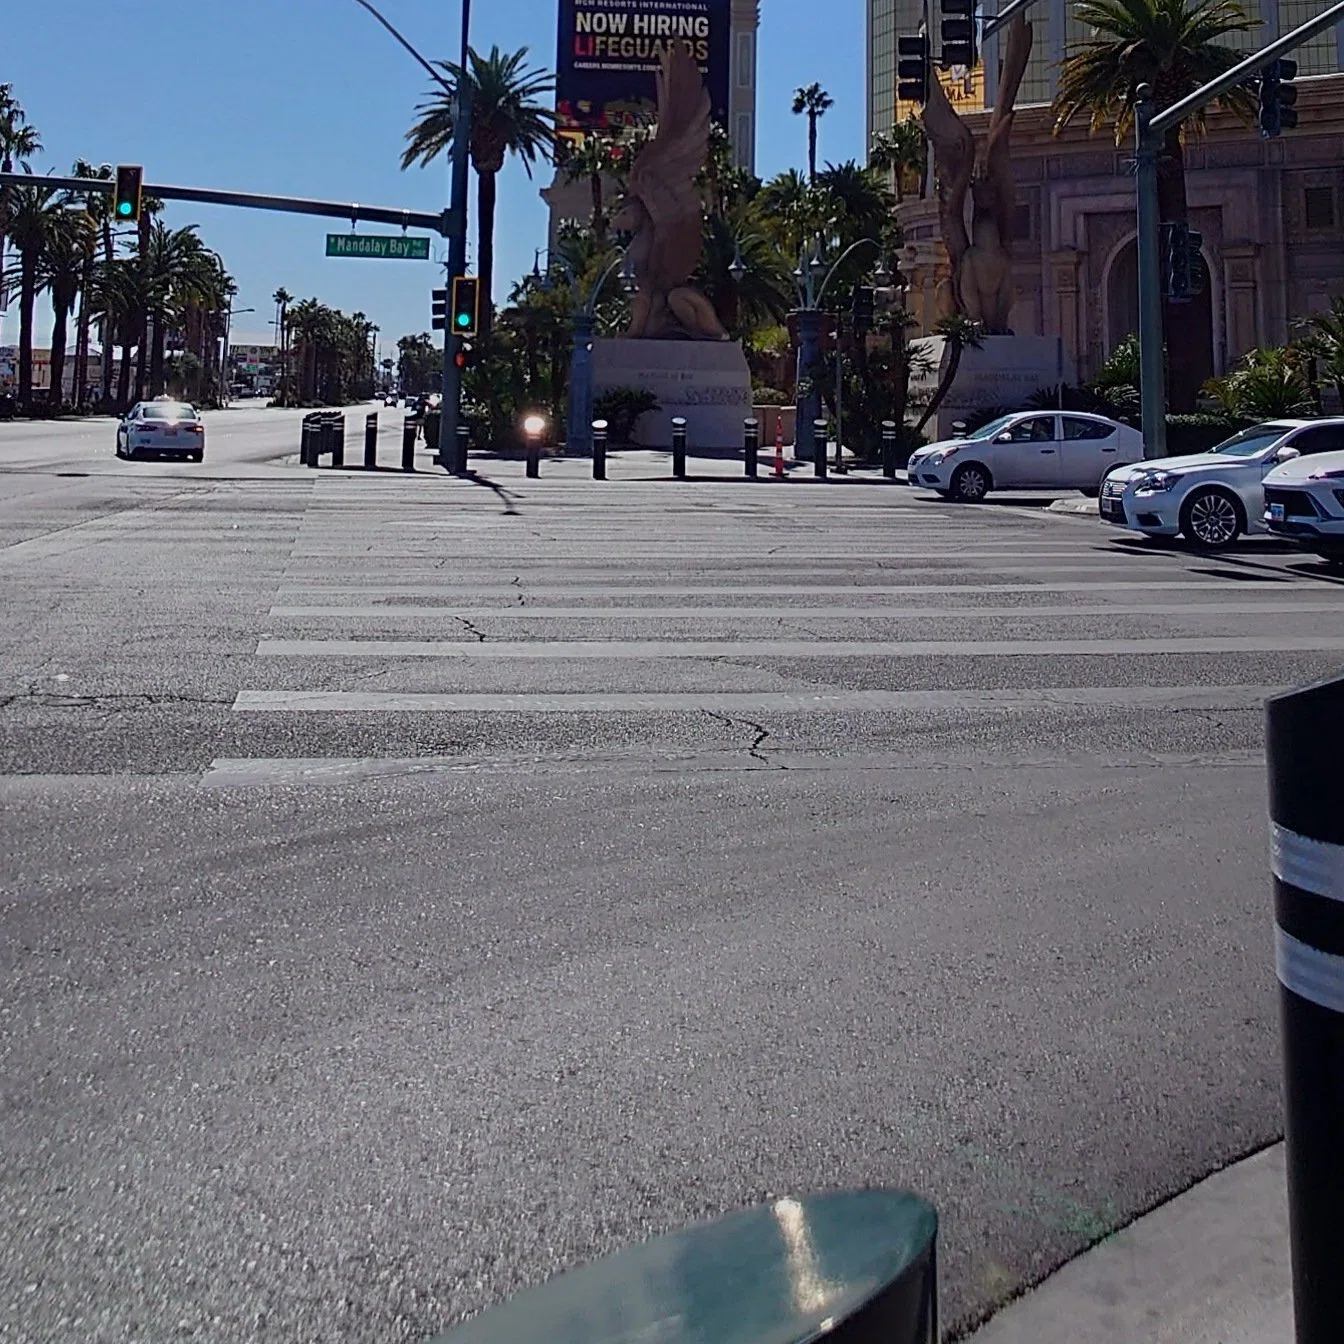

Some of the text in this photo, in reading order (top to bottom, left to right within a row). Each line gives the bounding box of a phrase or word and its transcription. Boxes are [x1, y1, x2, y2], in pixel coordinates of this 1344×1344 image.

[597, 0, 637, 8] RESORTS
[639, 1, 709, 11] INTERNATIONAL
[575, 11, 709, 37] NOW HIRING
[337, 236, 387, 256] Mandalay
[389, 239, 410, 256] Bay
